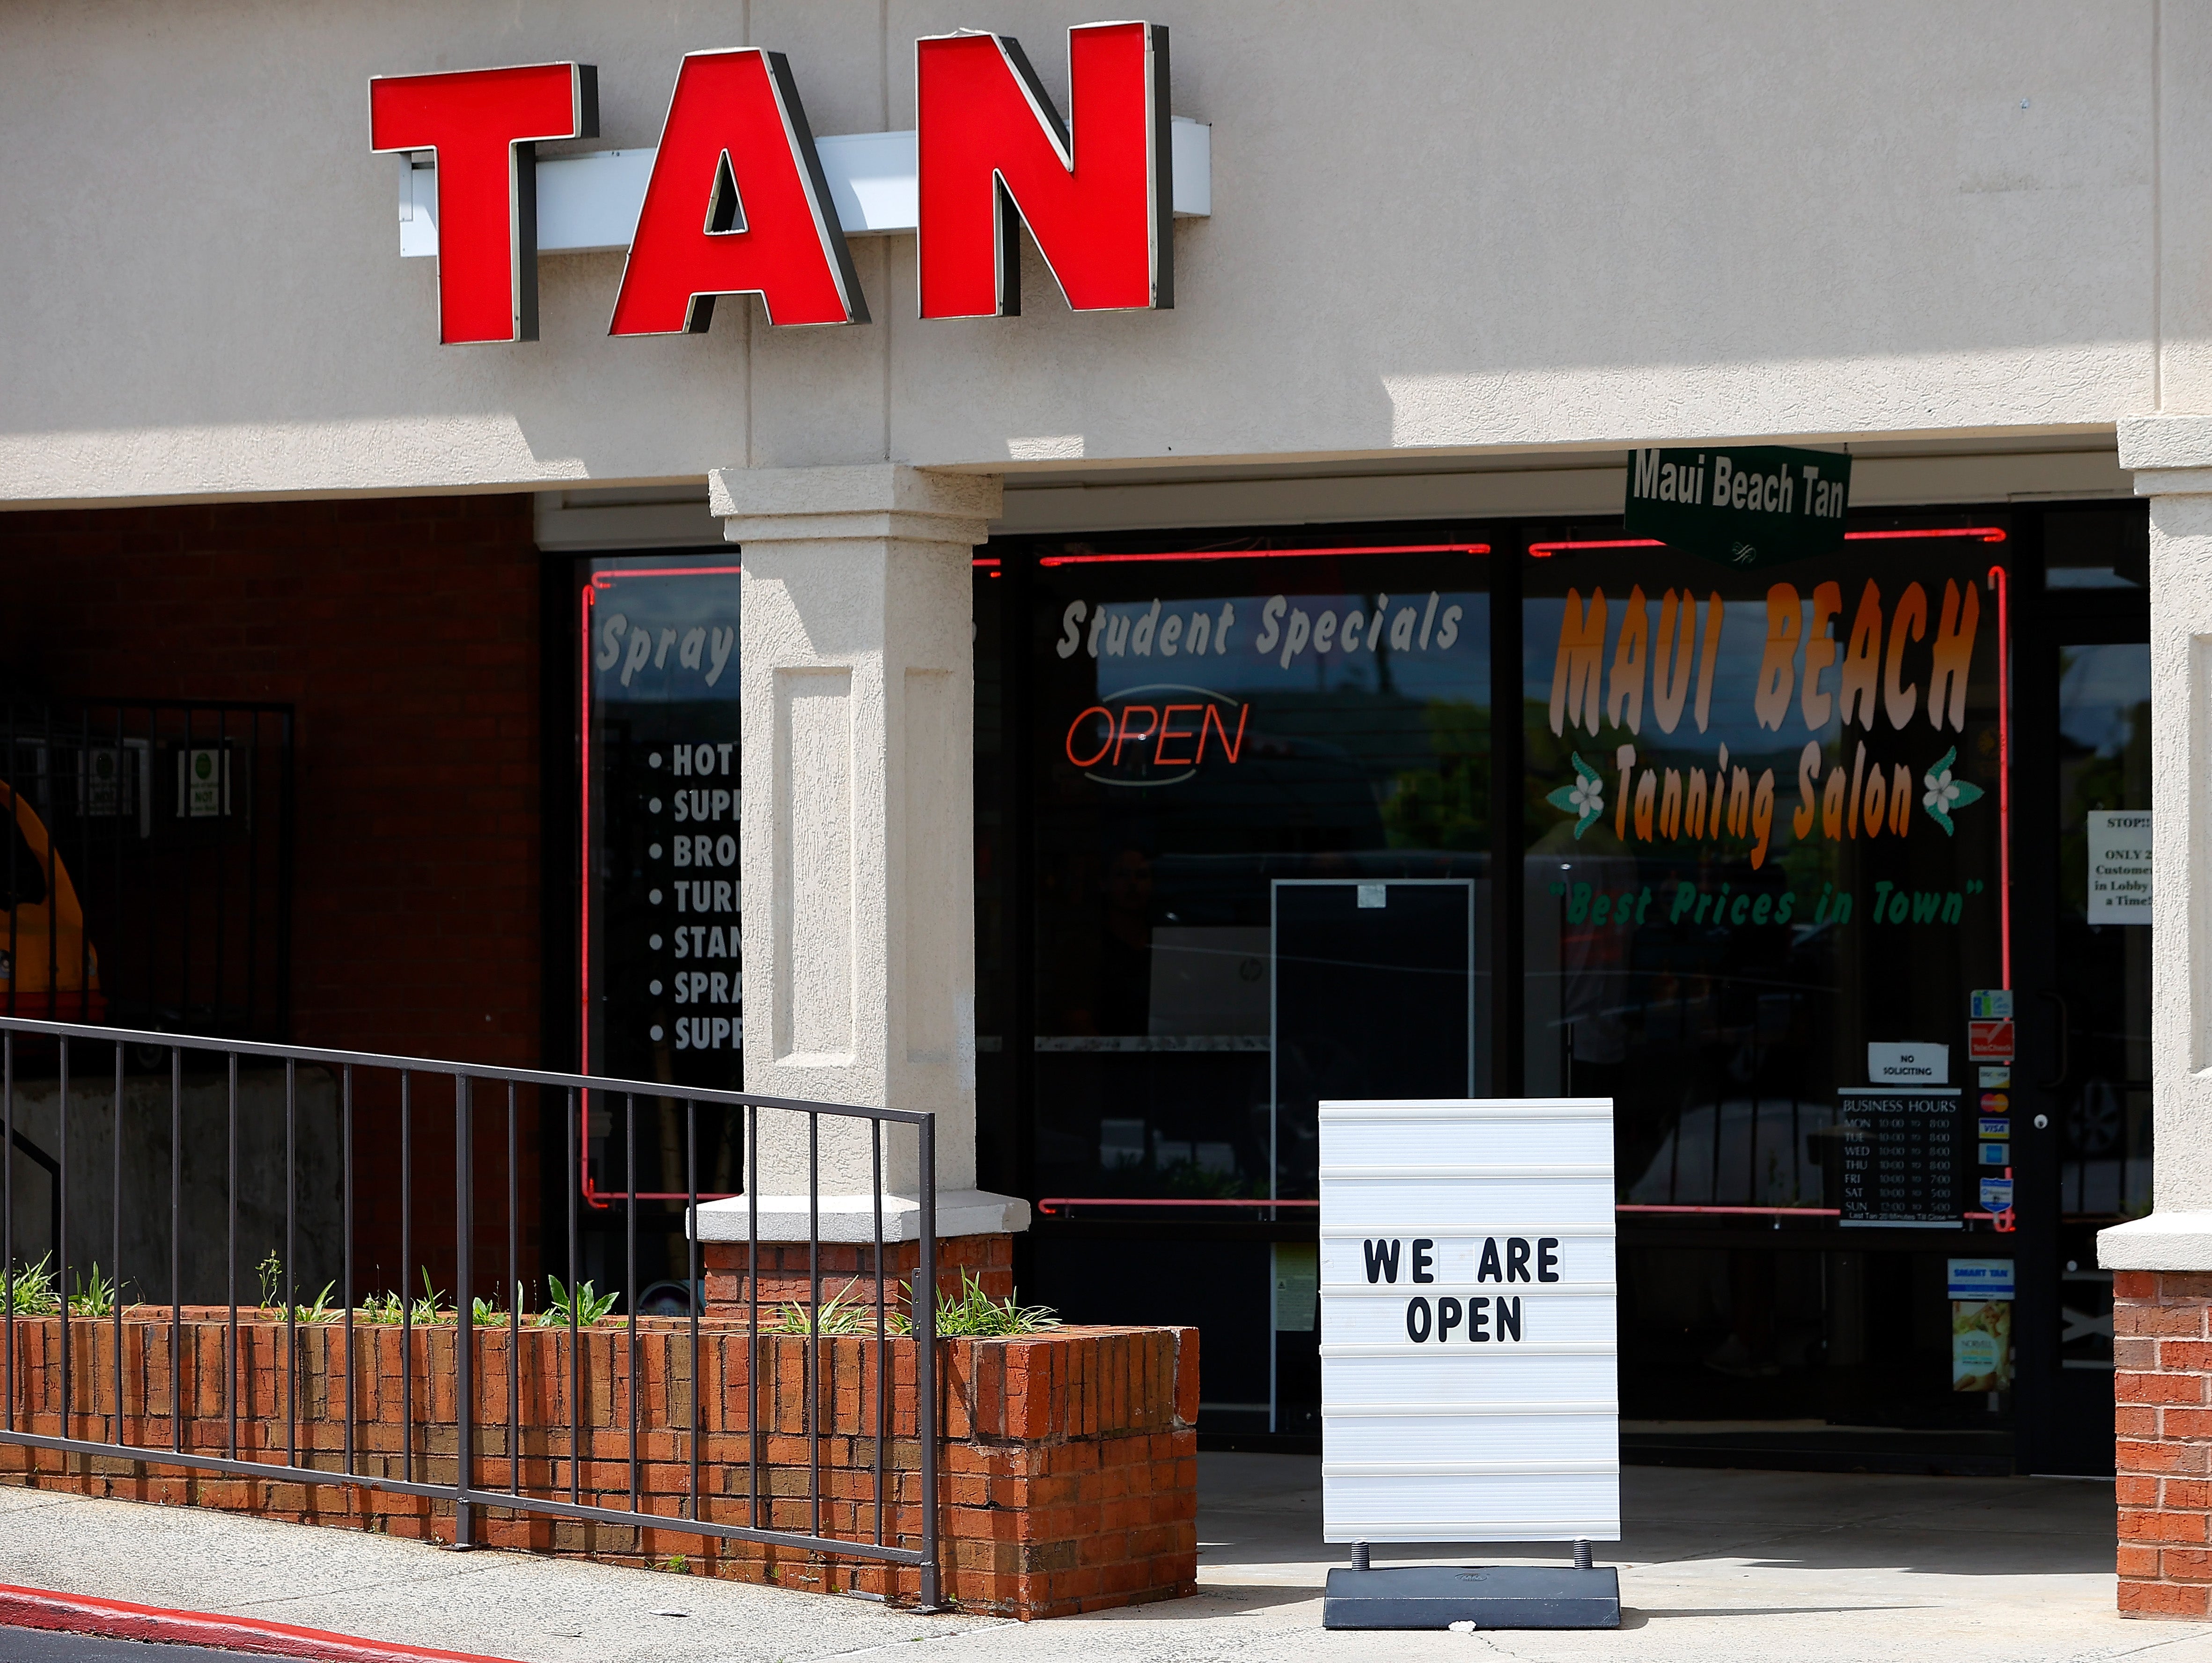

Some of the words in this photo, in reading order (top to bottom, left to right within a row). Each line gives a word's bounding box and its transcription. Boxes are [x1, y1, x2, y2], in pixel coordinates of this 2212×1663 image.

[369, 20, 1173, 344] TAN
[1633, 448, 1705, 504] Maui
[1712, 456, 1794, 513] Beach
[1803, 465, 1844, 518] Tan
[1056, 597, 1236, 659] Student
[1256, 590, 1464, 669] Specials
[596, 613, 734, 688] Spray
[1549, 583, 1724, 738] MAUI
[1754, 578, 1980, 735] BEACH
[1065, 702, 1249, 767] OPEN
[674, 743, 733, 776] HOT
[1615, 741, 1775, 870] Tanning
[1793, 739, 1913, 841] Salon
[674, 834, 740, 867] BRO
[2105, 850, 2142, 860] ONLY
[2145, 850, 2152, 860] 2
[1670, 881, 1794, 925] Prices
[1815, 883, 1853, 925] in
[2094, 881, 2106, 890] in
[2111, 881, 2148, 893] Lobby
[1843, 1099, 1903, 1113] BUSINESS
[1908, 1099, 1957, 1113] HOURS
[1844, 1147, 1870, 1156] WED
[1845, 1161, 1868, 1170] THU
[1844, 1174, 1860, 1184] FRI
[1930, 1174, 1950, 1184] 7:00
[1845, 1188, 1864, 1197] SAT
[1846, 1202, 1868, 1211] SUN
[1363, 1238, 1434, 1283] WE
[1477, 1237, 1559, 1283] ARE
[1954, 1268, 1986, 1277] SMART
[1990, 1269, 2008, 1277] TAN
[1407, 1296, 1521, 1343] OPEN
